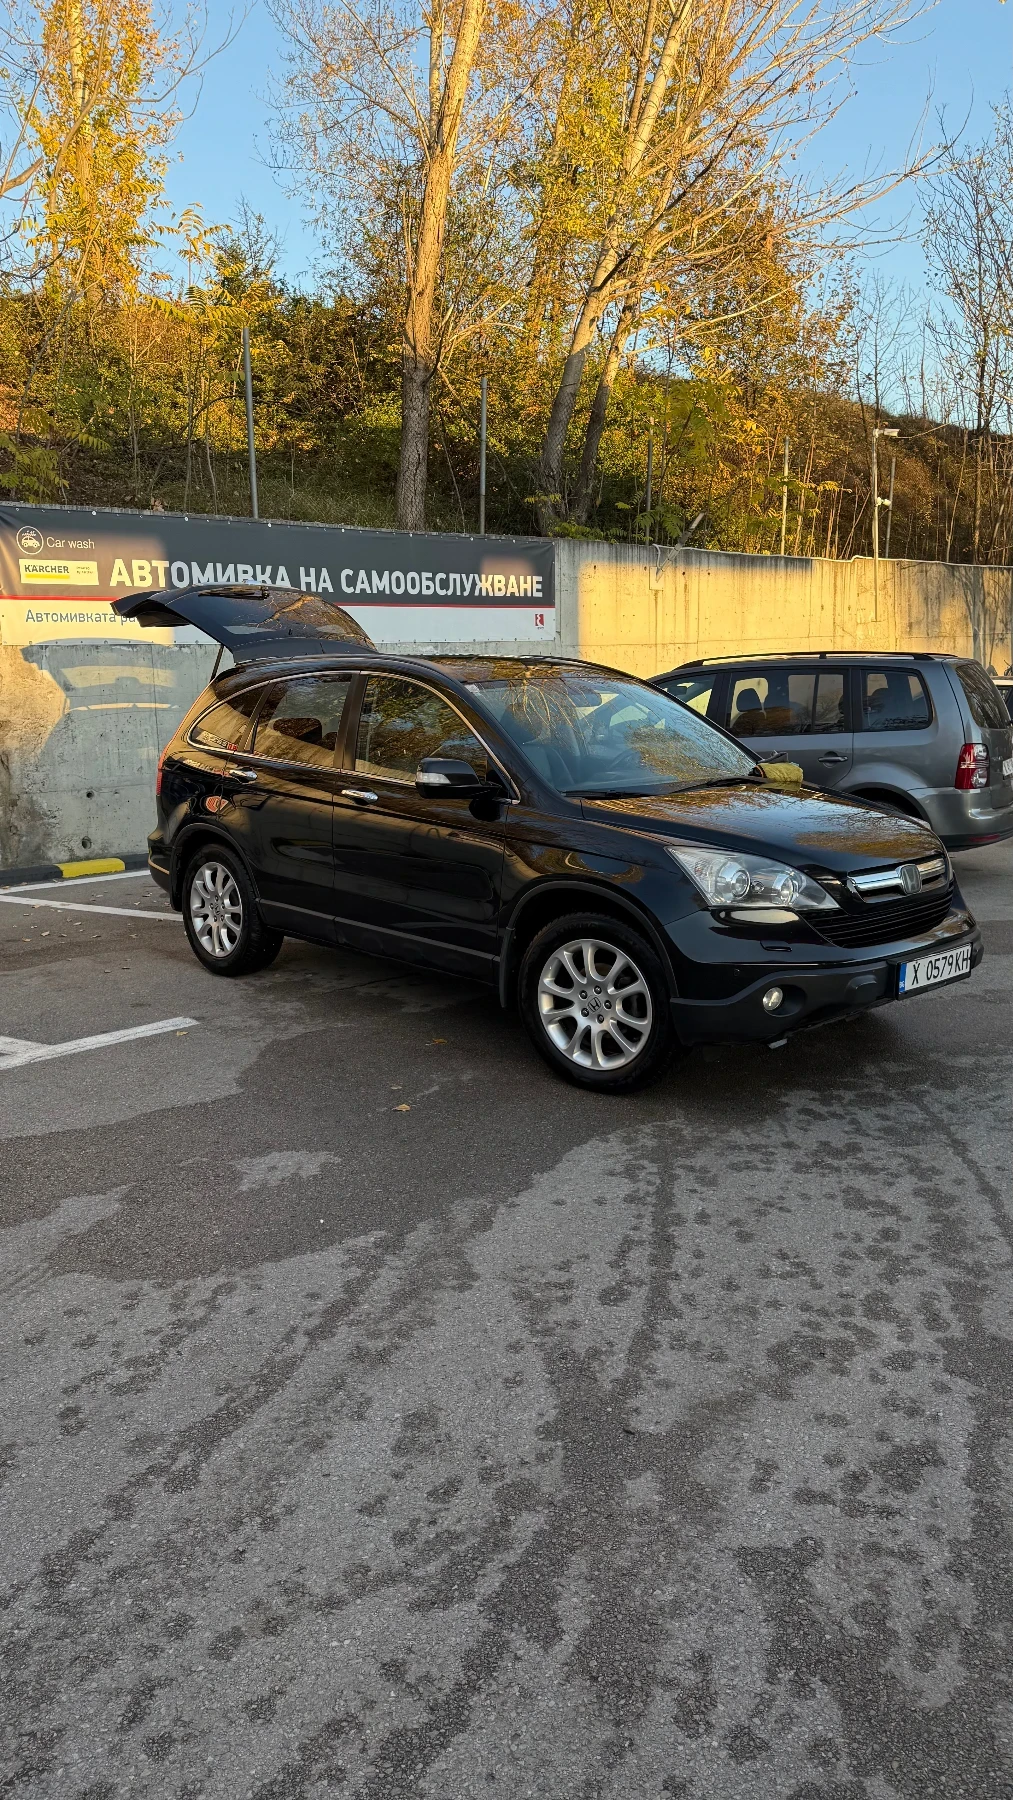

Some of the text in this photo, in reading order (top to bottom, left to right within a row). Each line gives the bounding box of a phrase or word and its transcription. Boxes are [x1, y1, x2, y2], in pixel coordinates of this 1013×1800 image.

[46, 536, 95, 549] Car wash
[24, 564, 70, 574] KÄRCHER
[109, 558, 543, 598] АВТОМИВКА НА САМООБСЛУЖВАНЕ
[25, 608, 117, 623] Автомивката
